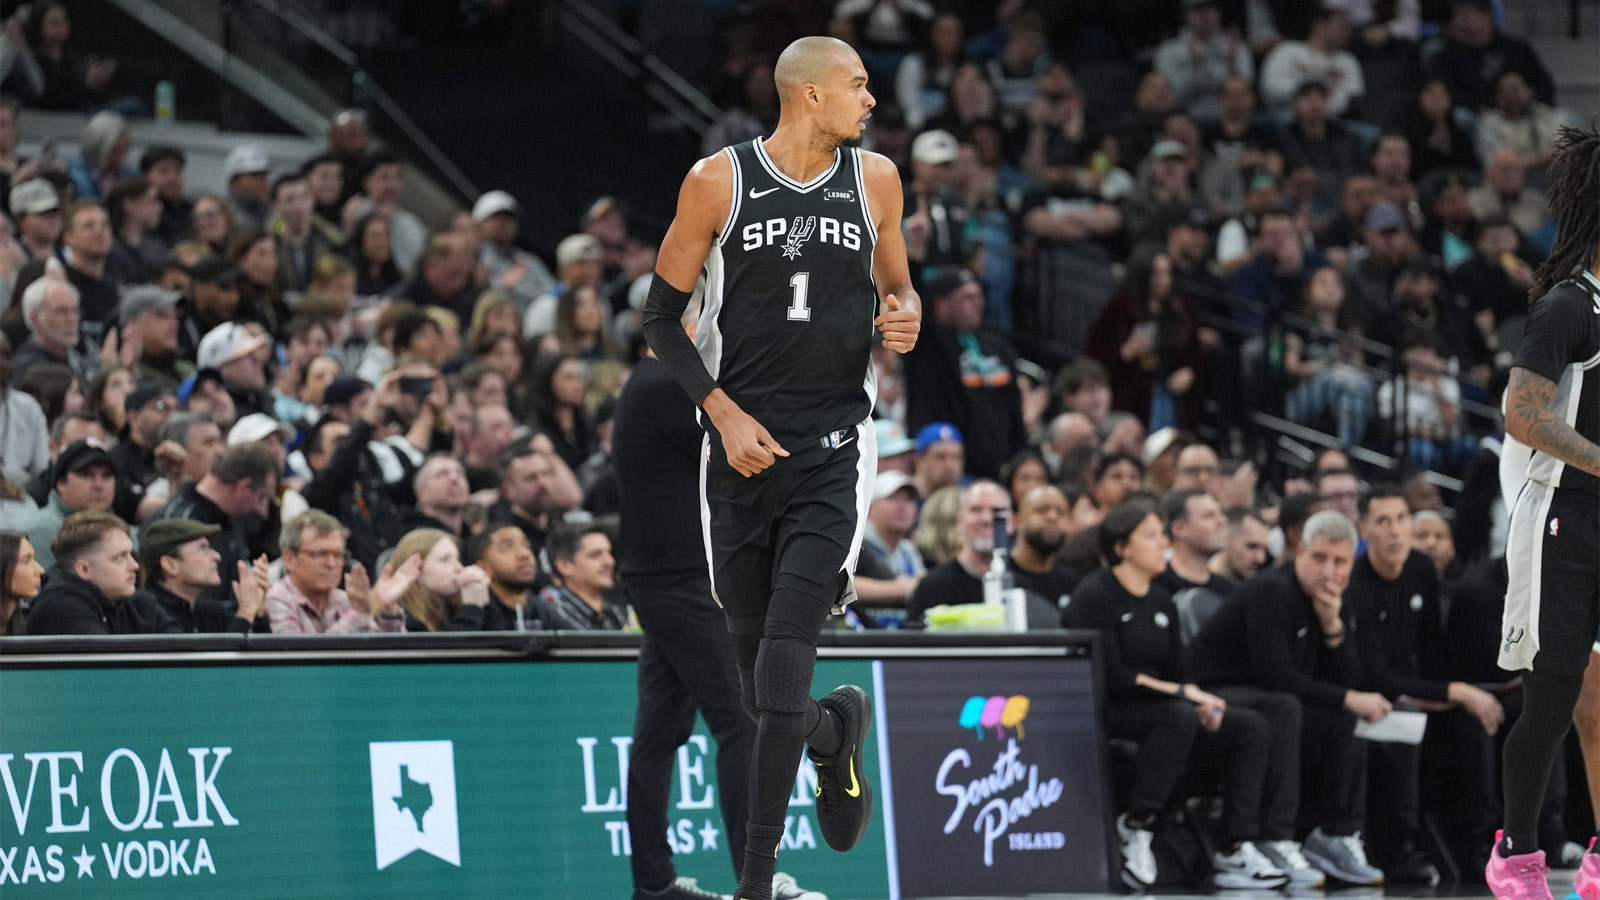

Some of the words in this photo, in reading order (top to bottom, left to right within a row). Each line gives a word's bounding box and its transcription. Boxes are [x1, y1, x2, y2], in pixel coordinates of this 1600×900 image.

[827, 191, 851, 199] LEDGER
[742, 216, 861, 260] SPURS
[787, 272, 811, 321] 1
[100, 746, 240, 833] OAK
[576, 734, 715, 813] LIE
[935, 738, 1027, 834] South
[973, 764, 1064, 867] Padre
[101, 837, 217, 880] VODKA
[1008, 831, 1066, 850] ISLAND
